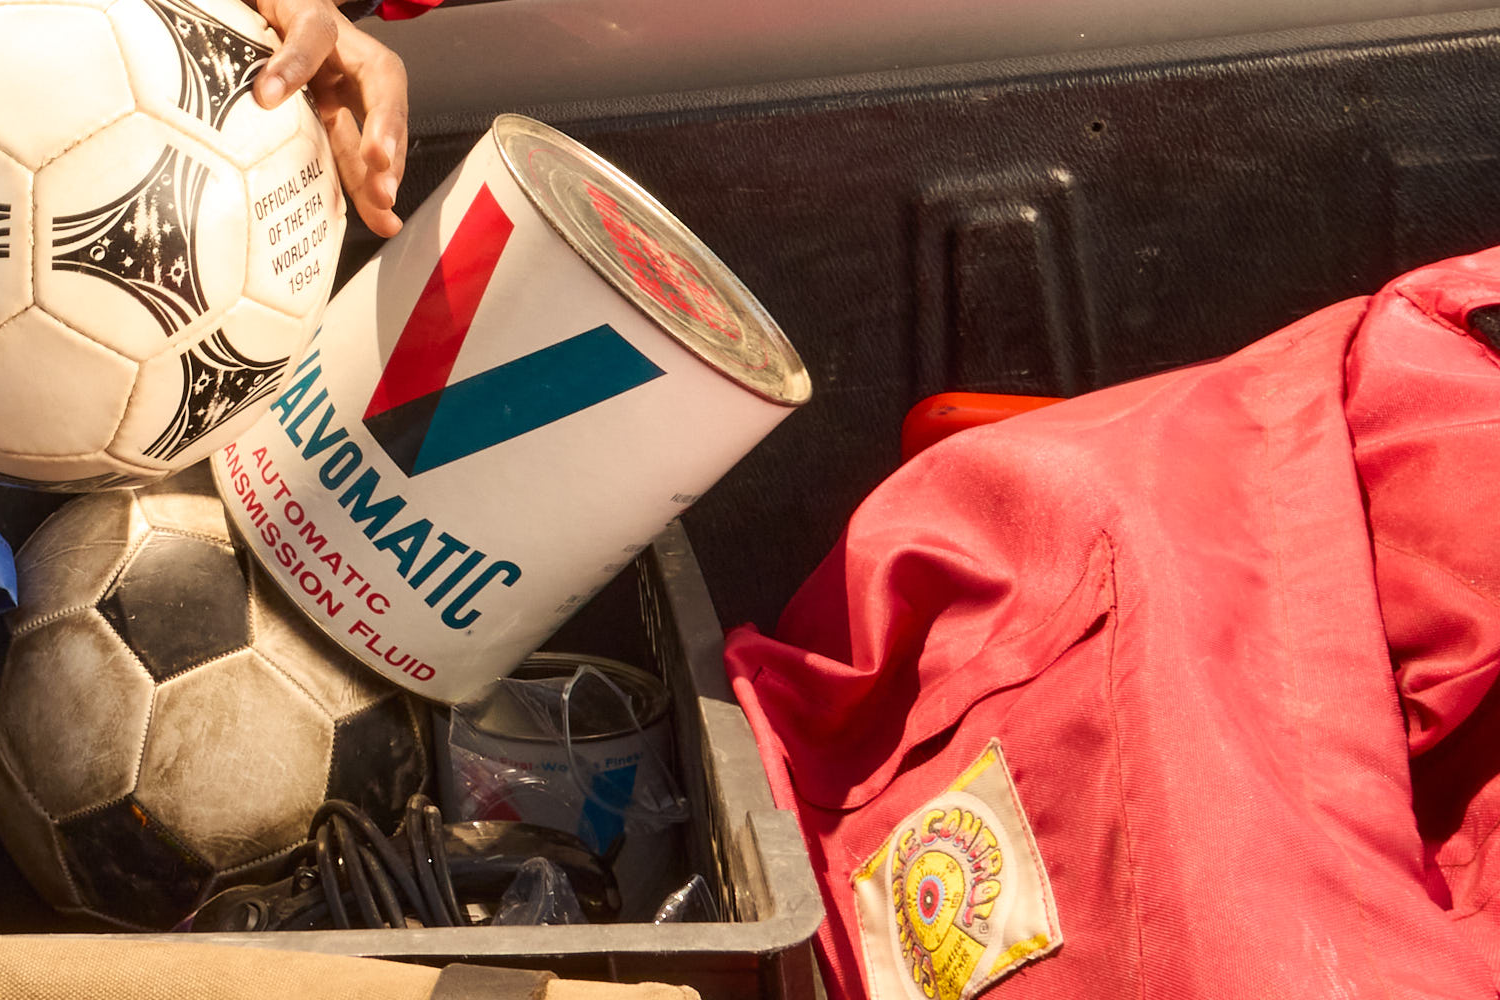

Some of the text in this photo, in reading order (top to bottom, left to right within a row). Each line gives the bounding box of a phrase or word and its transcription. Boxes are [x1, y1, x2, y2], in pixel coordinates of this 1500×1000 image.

[254, 157, 324, 221] OFFICIAL BALL
[268, 192, 324, 246] OF THE FIFA
[271, 219, 329, 276] WORLD CUP
[288, 259, 321, 295] 1994
[223, 442, 437, 683] ANSMISSION FLUID
[252, 446, 391, 615] AUTOMATIC
[920, 807, 1003, 929] CONTROL
